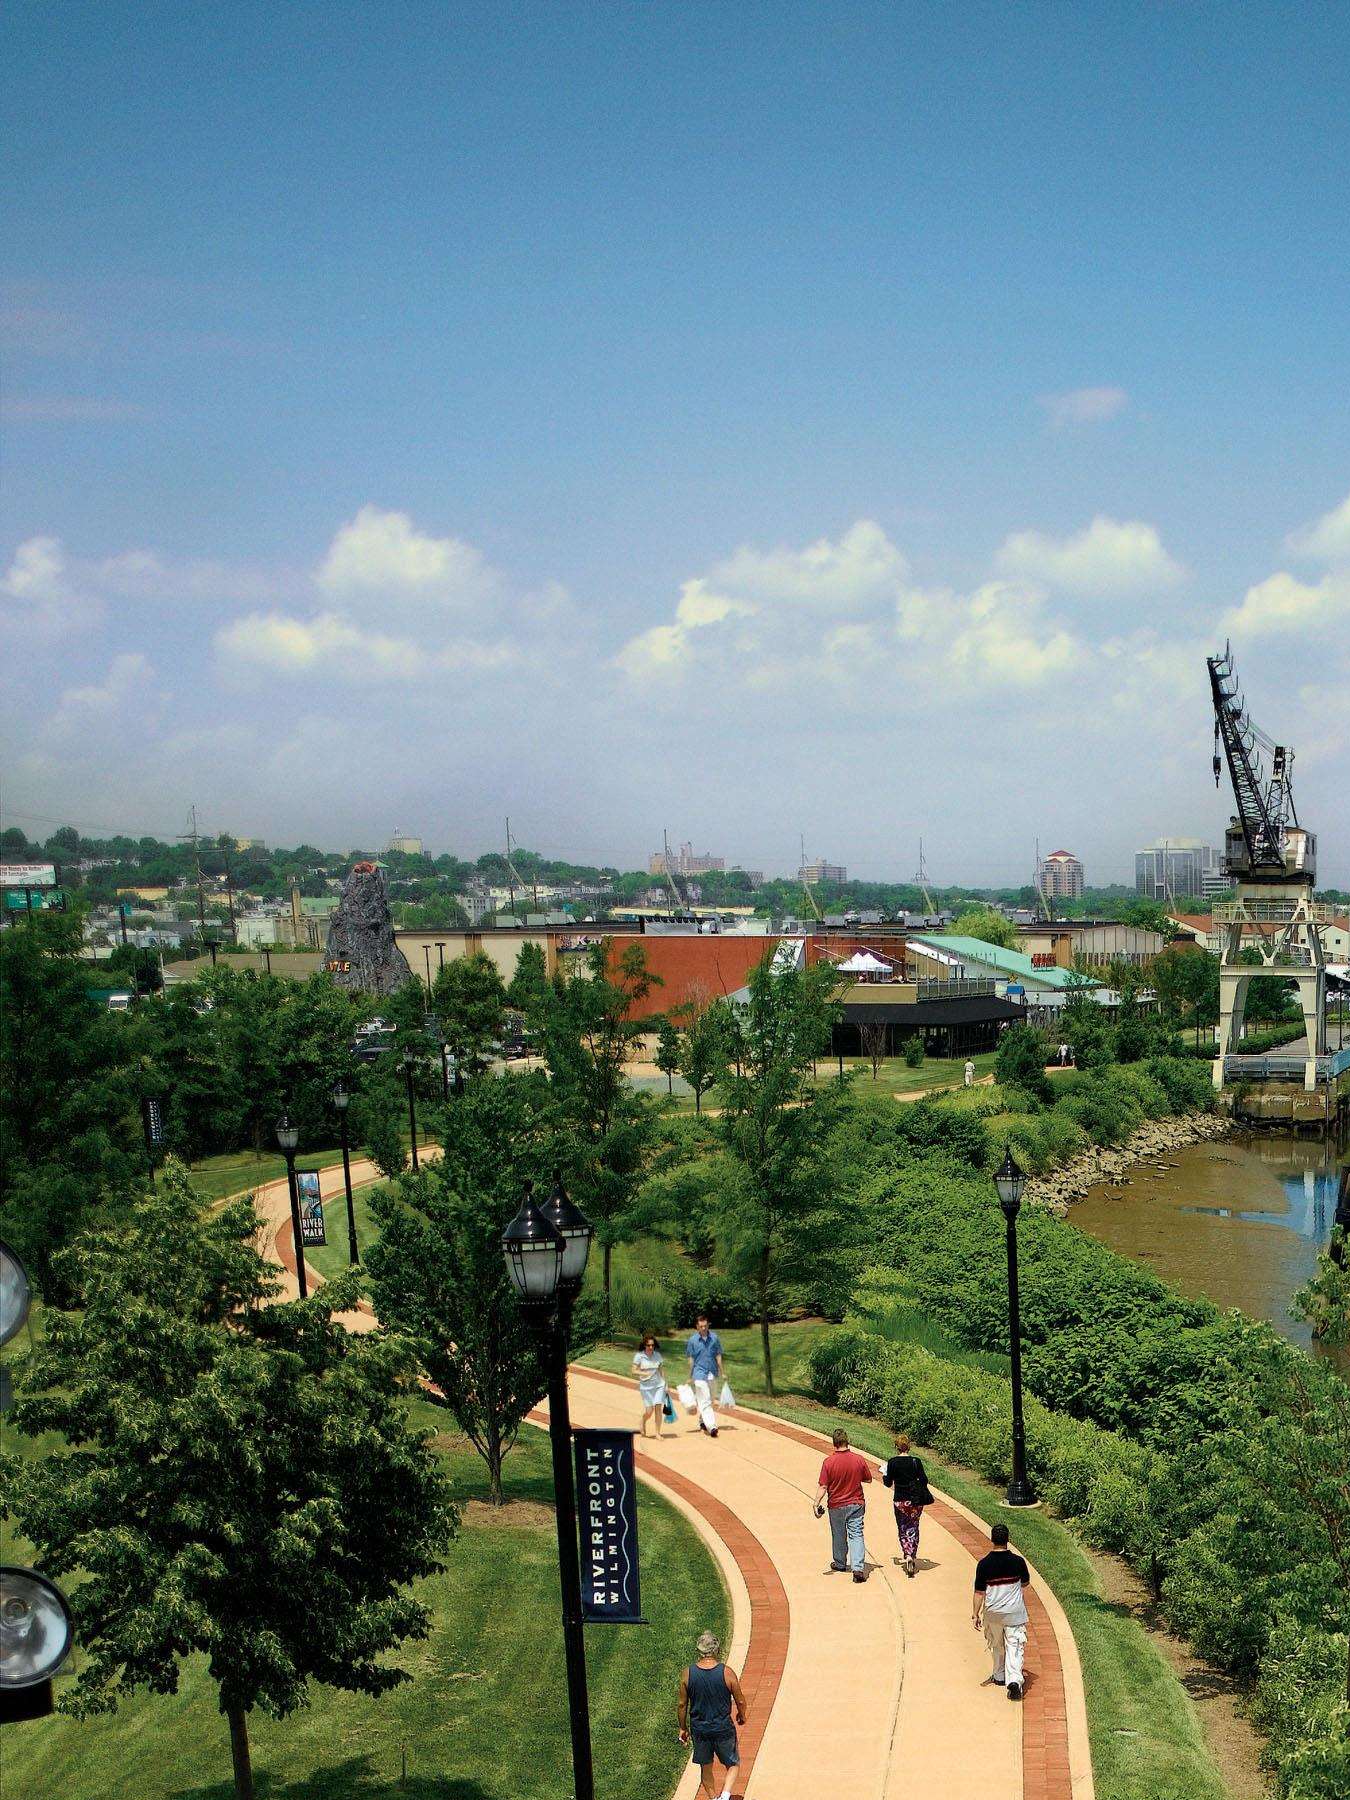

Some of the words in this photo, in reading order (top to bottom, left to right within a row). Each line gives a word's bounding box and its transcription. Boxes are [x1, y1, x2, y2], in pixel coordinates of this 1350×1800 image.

[302, 1218, 323, 1228] RIVER
[303, 1228, 324, 1237] WALK
[586, 1448, 606, 1605] RIVERFRONT
[603, 1448, 619, 1604] WILMINGTON
